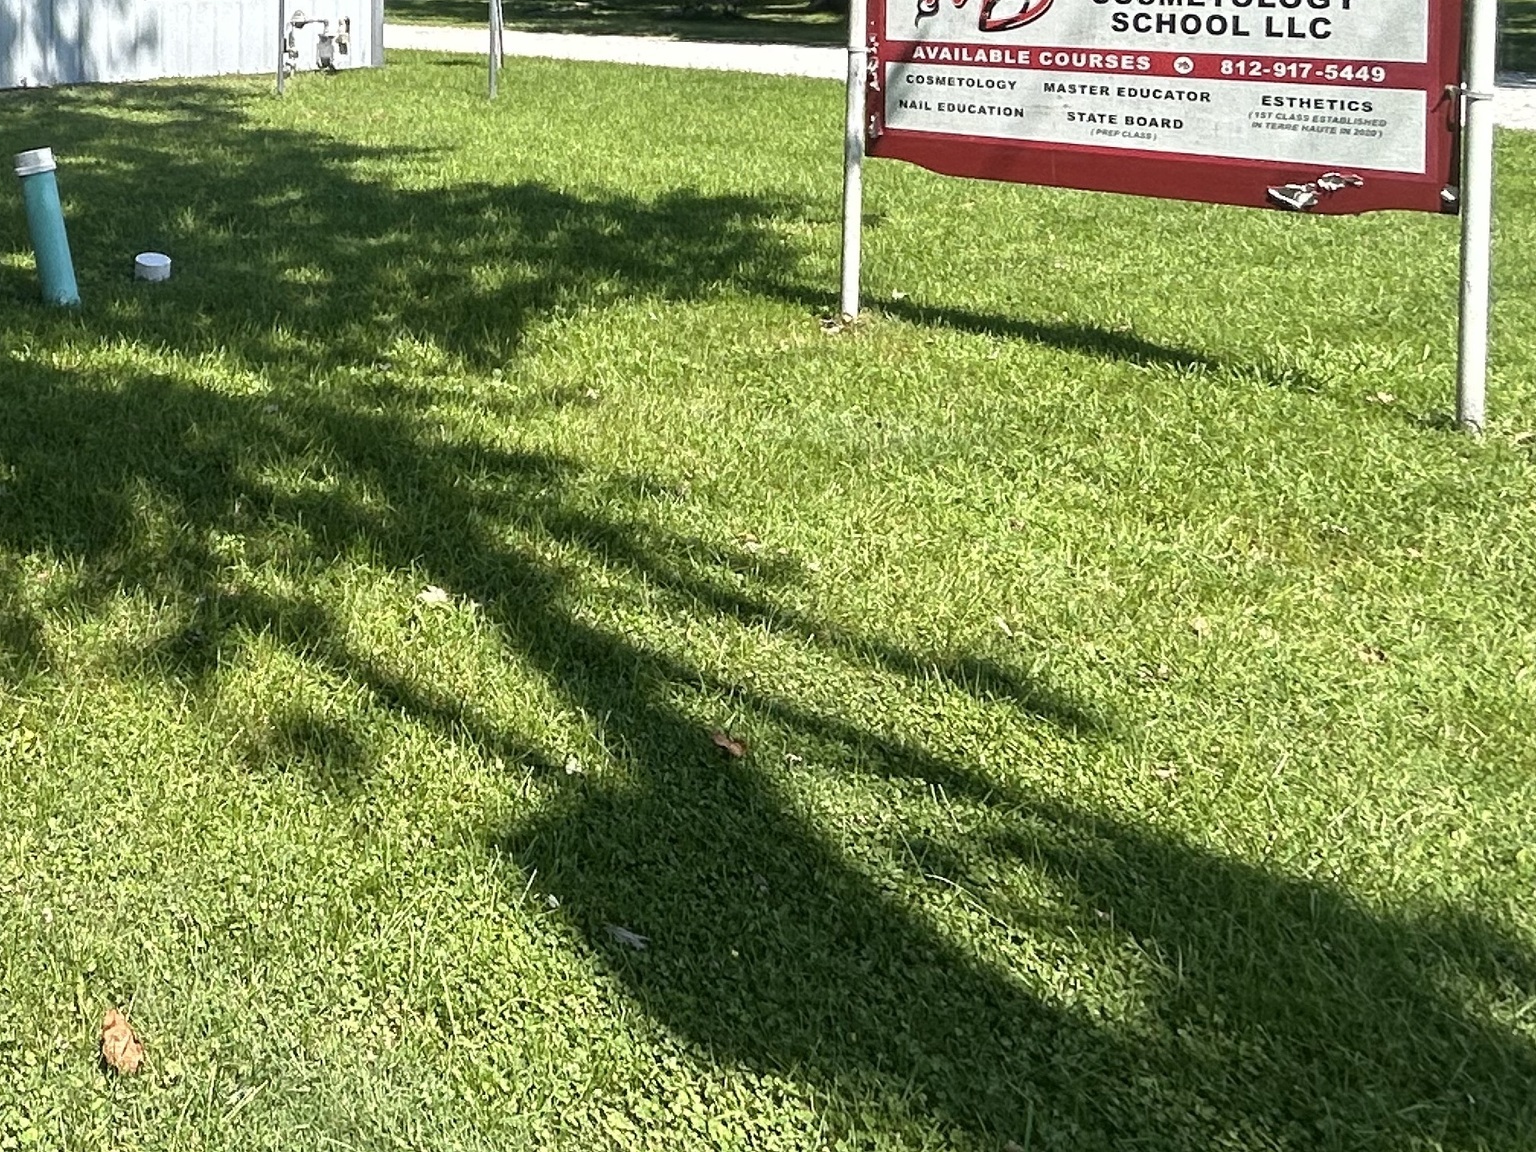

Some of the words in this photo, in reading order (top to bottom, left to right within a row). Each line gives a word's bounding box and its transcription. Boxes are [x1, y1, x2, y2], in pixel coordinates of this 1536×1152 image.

[1111, 12, 1250, 37] SCHOOL
[1265, 16, 1332, 40] LLC
[913, 46, 1030, 64] AVAILABLE
[1039, 51, 1151, 70] COURSES
[1220, 59, 1386, 82] 812-917-5449
[906, 74, 1017, 90] COSMETOLOGY
[1043, 82, 1110, 97] MASTER
[1117, 87, 1211, 102] EDUCATOR
[899, 99, 932, 111] NAIL
[938, 102, 1024, 118] EDUCATION
[1261, 95, 1373, 112] ESTHETICS
[1067, 111, 1118, 125] STATE
[1125, 116, 1184, 129] BOARD
[1265, 122, 1299, 132] TERRE
[1301, 125, 1337, 135] HAUTE
[1275, 113, 1310, 122] CLASS
[1312, 115, 1387, 127] ESTABLISHED
